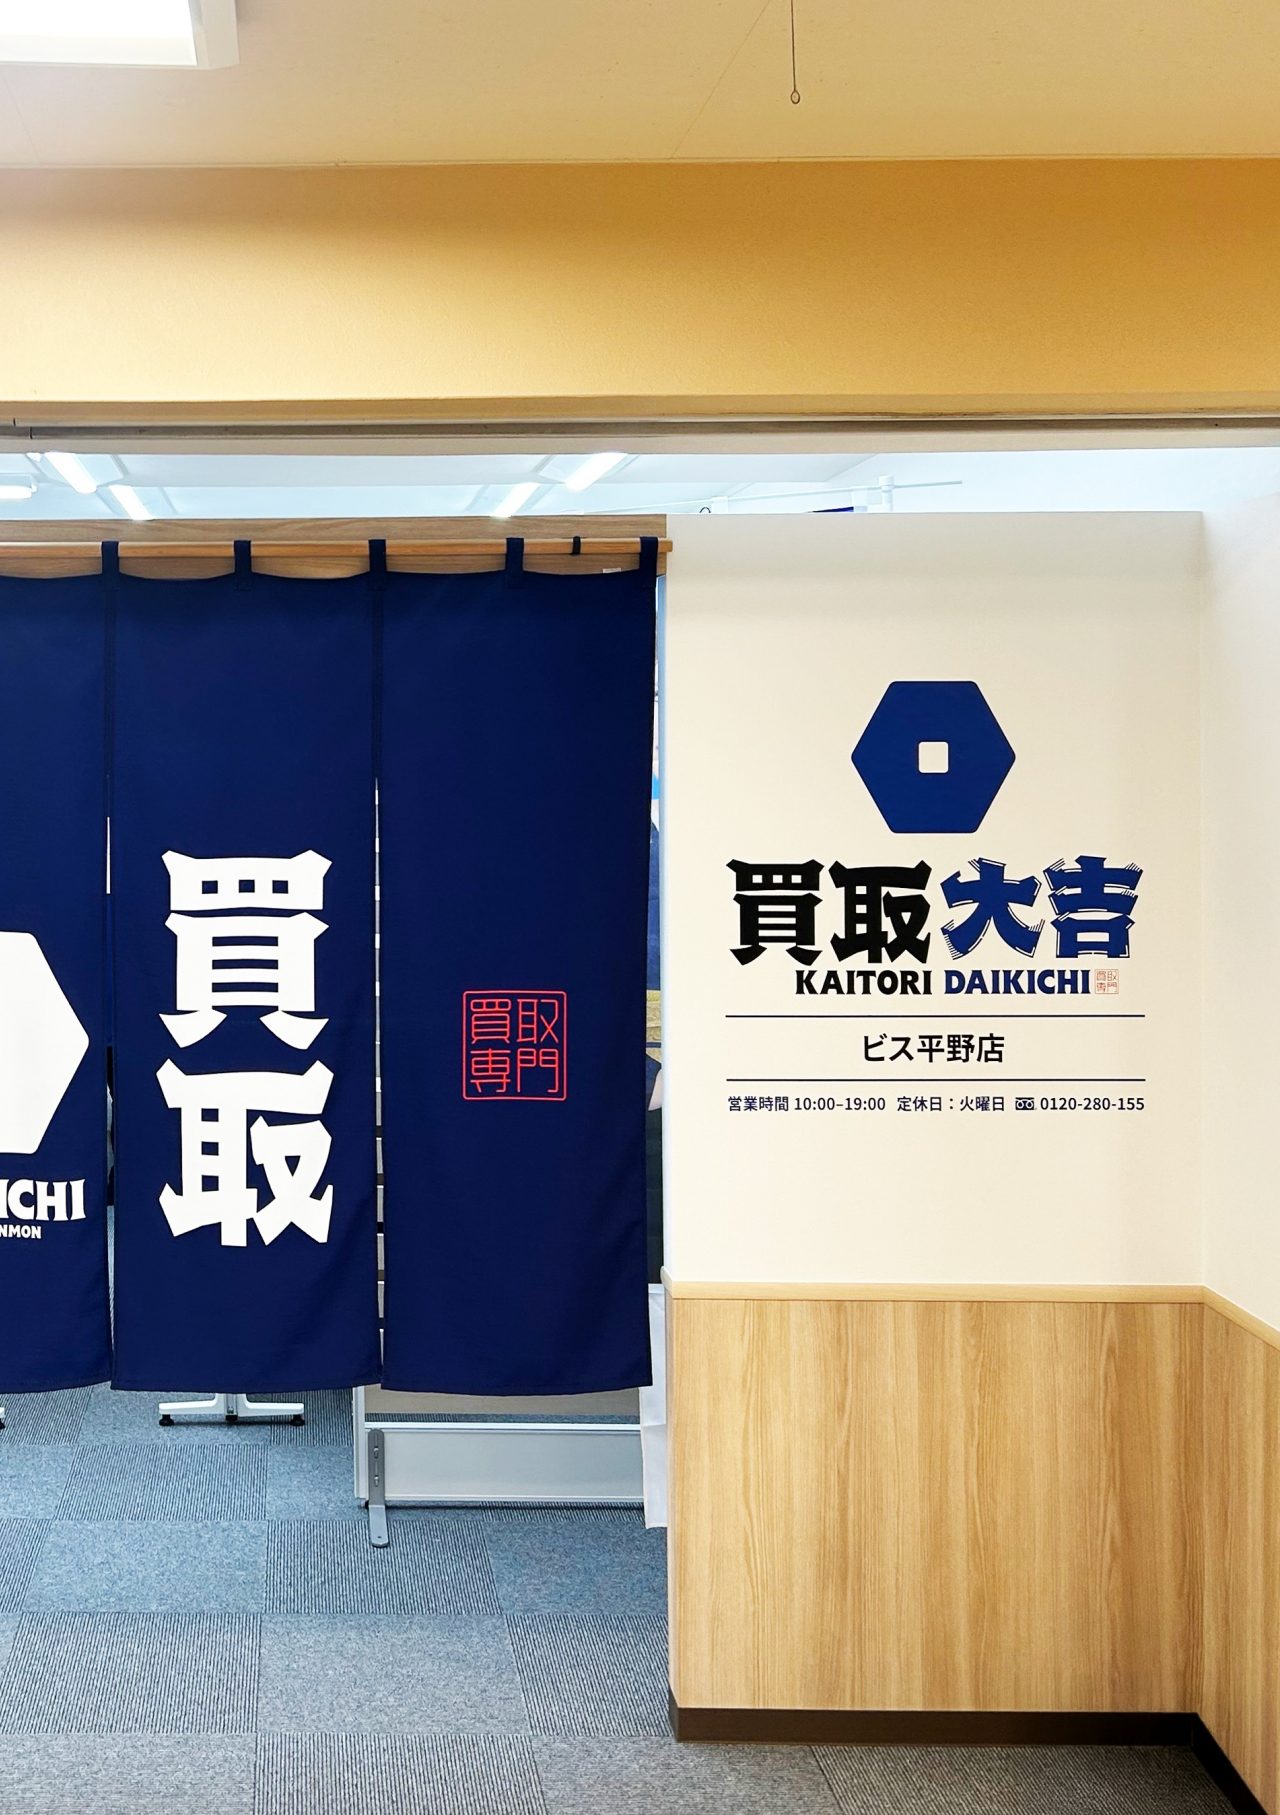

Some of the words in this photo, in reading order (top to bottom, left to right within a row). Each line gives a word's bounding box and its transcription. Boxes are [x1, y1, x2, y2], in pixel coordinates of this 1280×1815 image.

[726, 855, 1144, 966] 買取大吉
[795, 969, 933, 996] KAITORI
[943, 969, 1091, 995] DAIKICHI
[157, 850, 334, 1247] 買取
[863, 1033, 1005, 1064] ビス平野店
[727, 1096, 789, 1112] 営業時間
[1040, 1097, 1145, 1111] 0120-280-155
